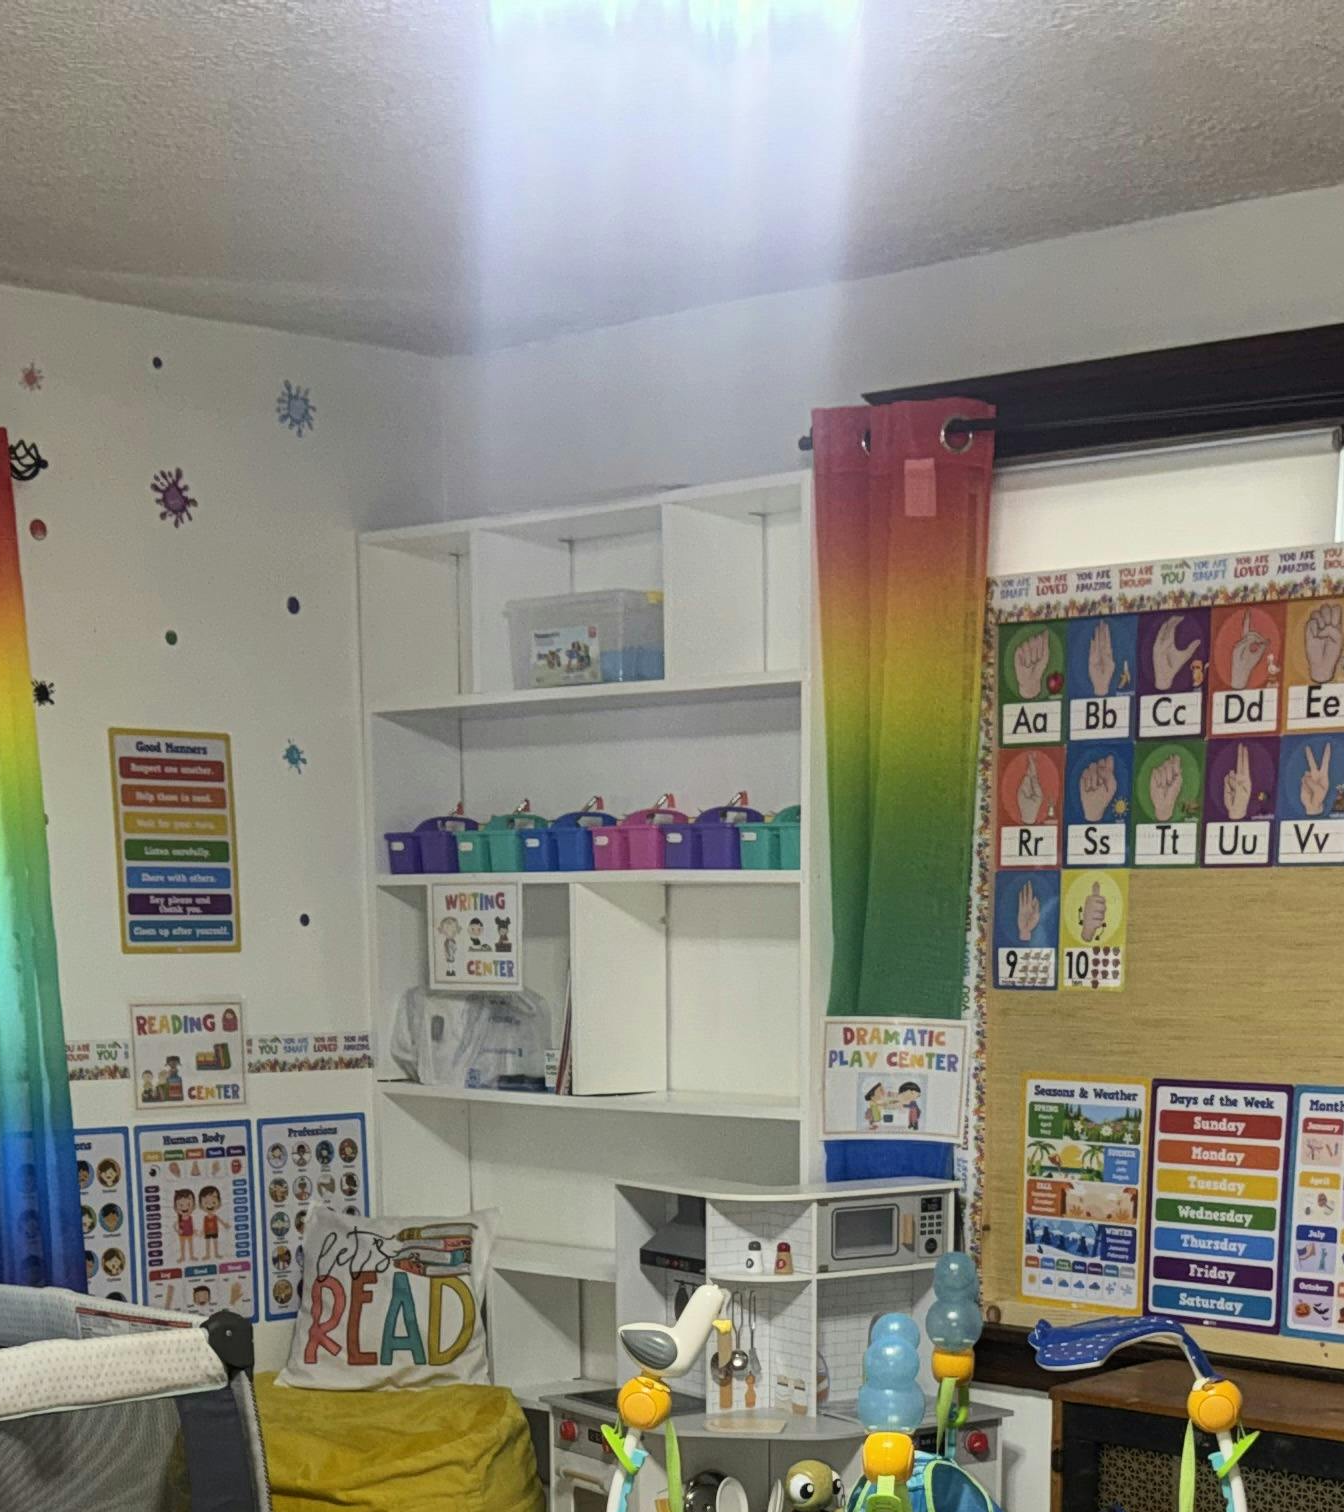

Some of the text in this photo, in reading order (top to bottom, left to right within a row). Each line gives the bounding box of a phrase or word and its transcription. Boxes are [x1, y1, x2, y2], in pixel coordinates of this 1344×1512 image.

[1152, 698, 1186, 727] Cc
[1223, 694, 1263, 723] Dd
[1306, 686, 1340, 717] Ee
[1013, 707, 1049, 735] Aa
[1084, 704, 1118, 730] Bb
[136, 741, 162, 753] Good
[1018, 830, 1043, 857] Rr
[1084, 827, 1111, 855] Ss
[1156, 825, 1179, 855] Tt
[1218, 824, 1257, 856] Uu
[1294, 823, 1330, 854] Vv
[444, 891, 506, 914] WRITING
[466, 959, 514, 979] CENTER
[1006, 951, 1018, 978] 9
[1065, 951, 1089, 977] 10
[136, 1013, 216, 1036] READING
[842, 1025, 947, 1047] DRAMATIC
[828, 1049, 959, 1073] PLAY CENTER
[187, 1084, 240, 1100] CENTER
[1034, 1085, 1076, 1099] Seasons
[1094, 1088, 1138, 1101] Weather
[1170, 1093, 1274, 1110] Days of the Week
[287, 1125, 338, 1138] Professions
[1193, 1116, 1246, 1135] Sunday
[162, 1132, 226, 1146] Human Body
[1191, 1147, 1245, 1166] Monday
[1187, 1175, 1245, 1196] Tuesday
[1177, 1205, 1253, 1227] Wednesday
[1180, 1233, 1247, 1256] Thursday
[1188, 1263, 1236, 1284] Friday
[1178, 1292, 1243, 1314] Saturday
[304, 1271, 476, 1367] READ
